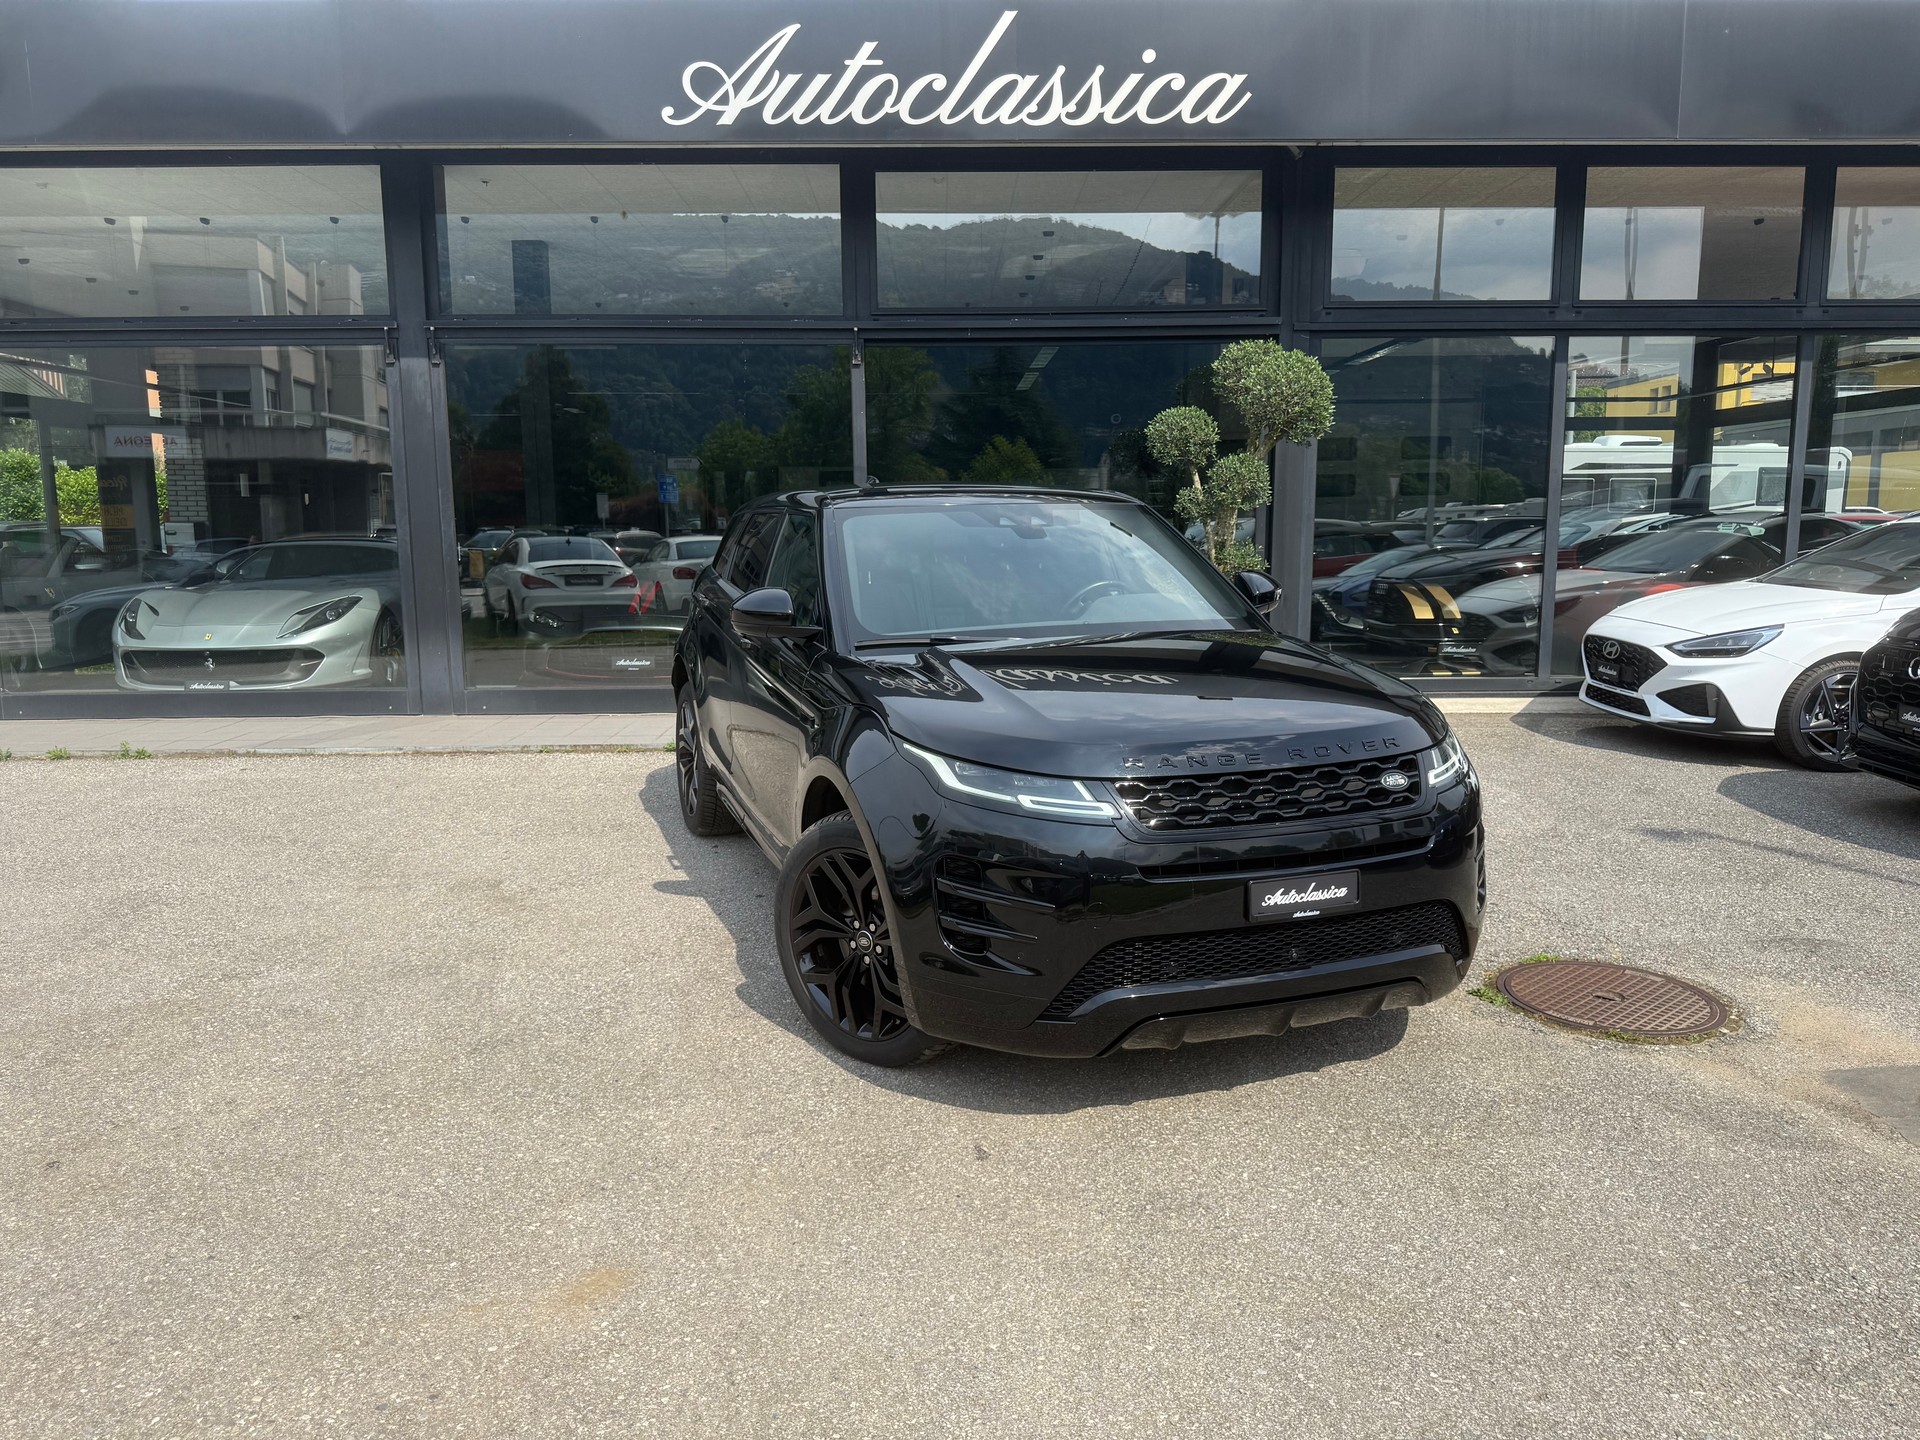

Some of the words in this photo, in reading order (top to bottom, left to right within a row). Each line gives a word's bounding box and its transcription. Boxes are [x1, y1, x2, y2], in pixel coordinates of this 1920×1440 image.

[661, 10, 1252, 126] Autoclassica
[1122, 752, 1263, 770] RANGE
[1288, 737, 1401, 760] ROVER
[1261, 882, 1348, 907] Autoclassica
